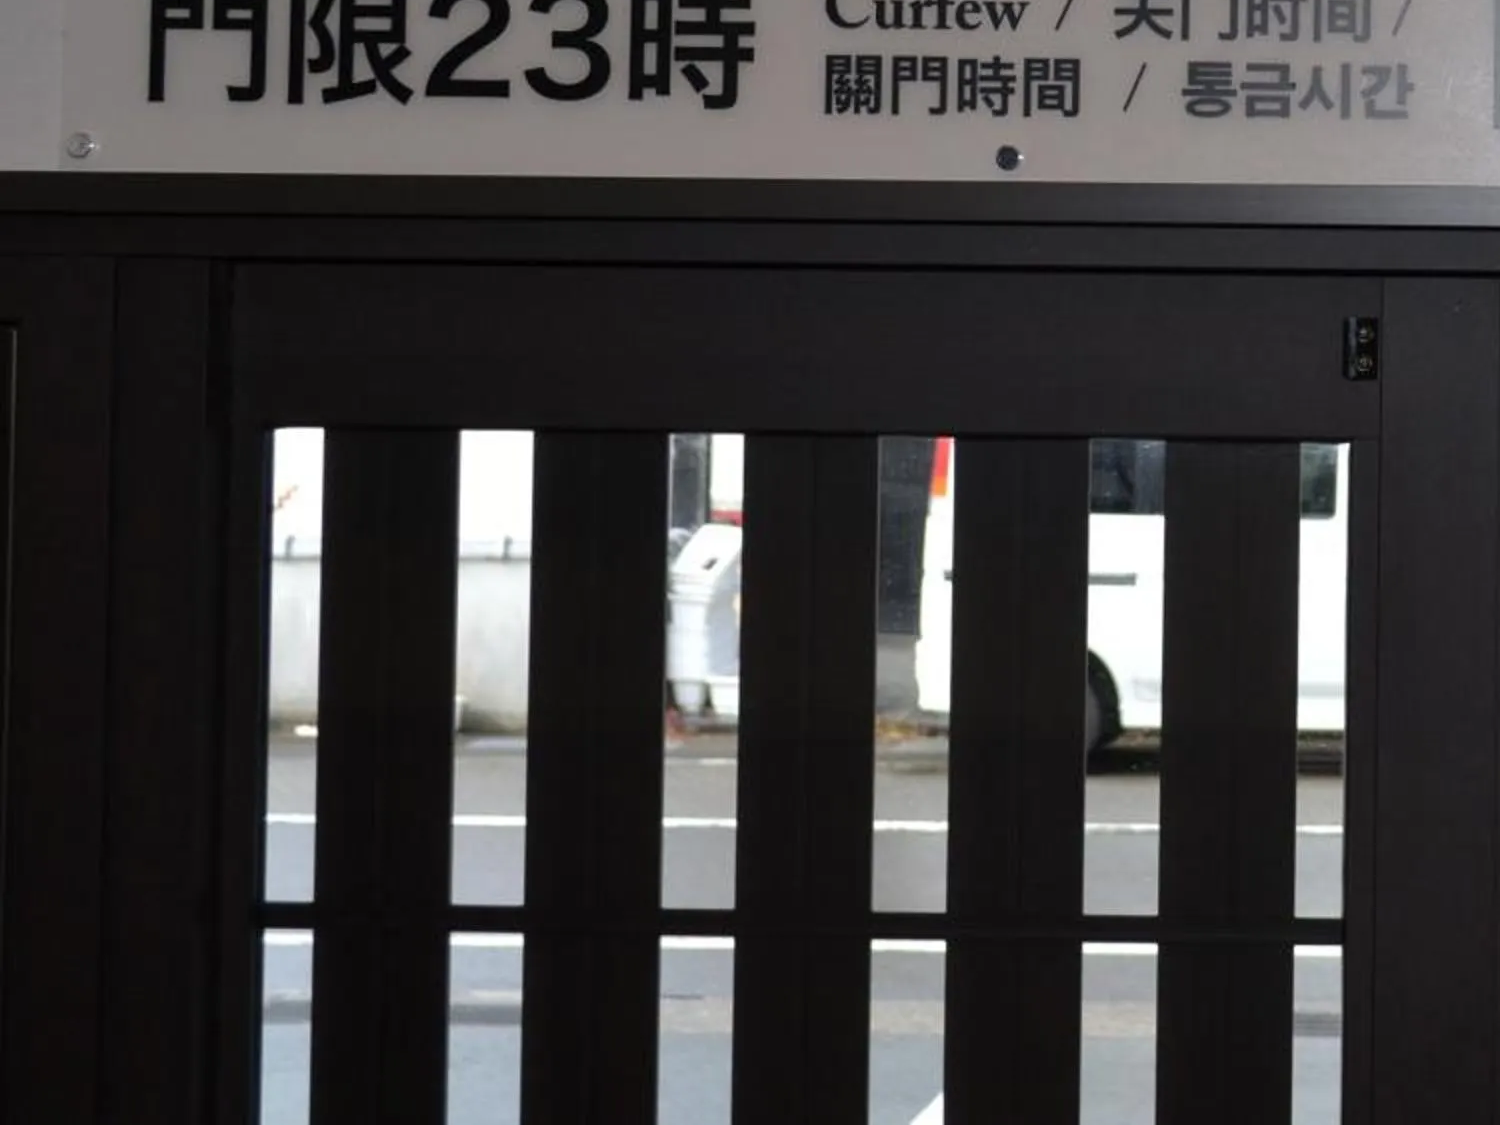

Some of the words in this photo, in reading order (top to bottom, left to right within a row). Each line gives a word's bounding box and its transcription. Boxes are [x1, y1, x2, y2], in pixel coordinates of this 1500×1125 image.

[823, 55, 1082, 118] 關門時間
[1181, 61, 1415, 121] 통금시간
